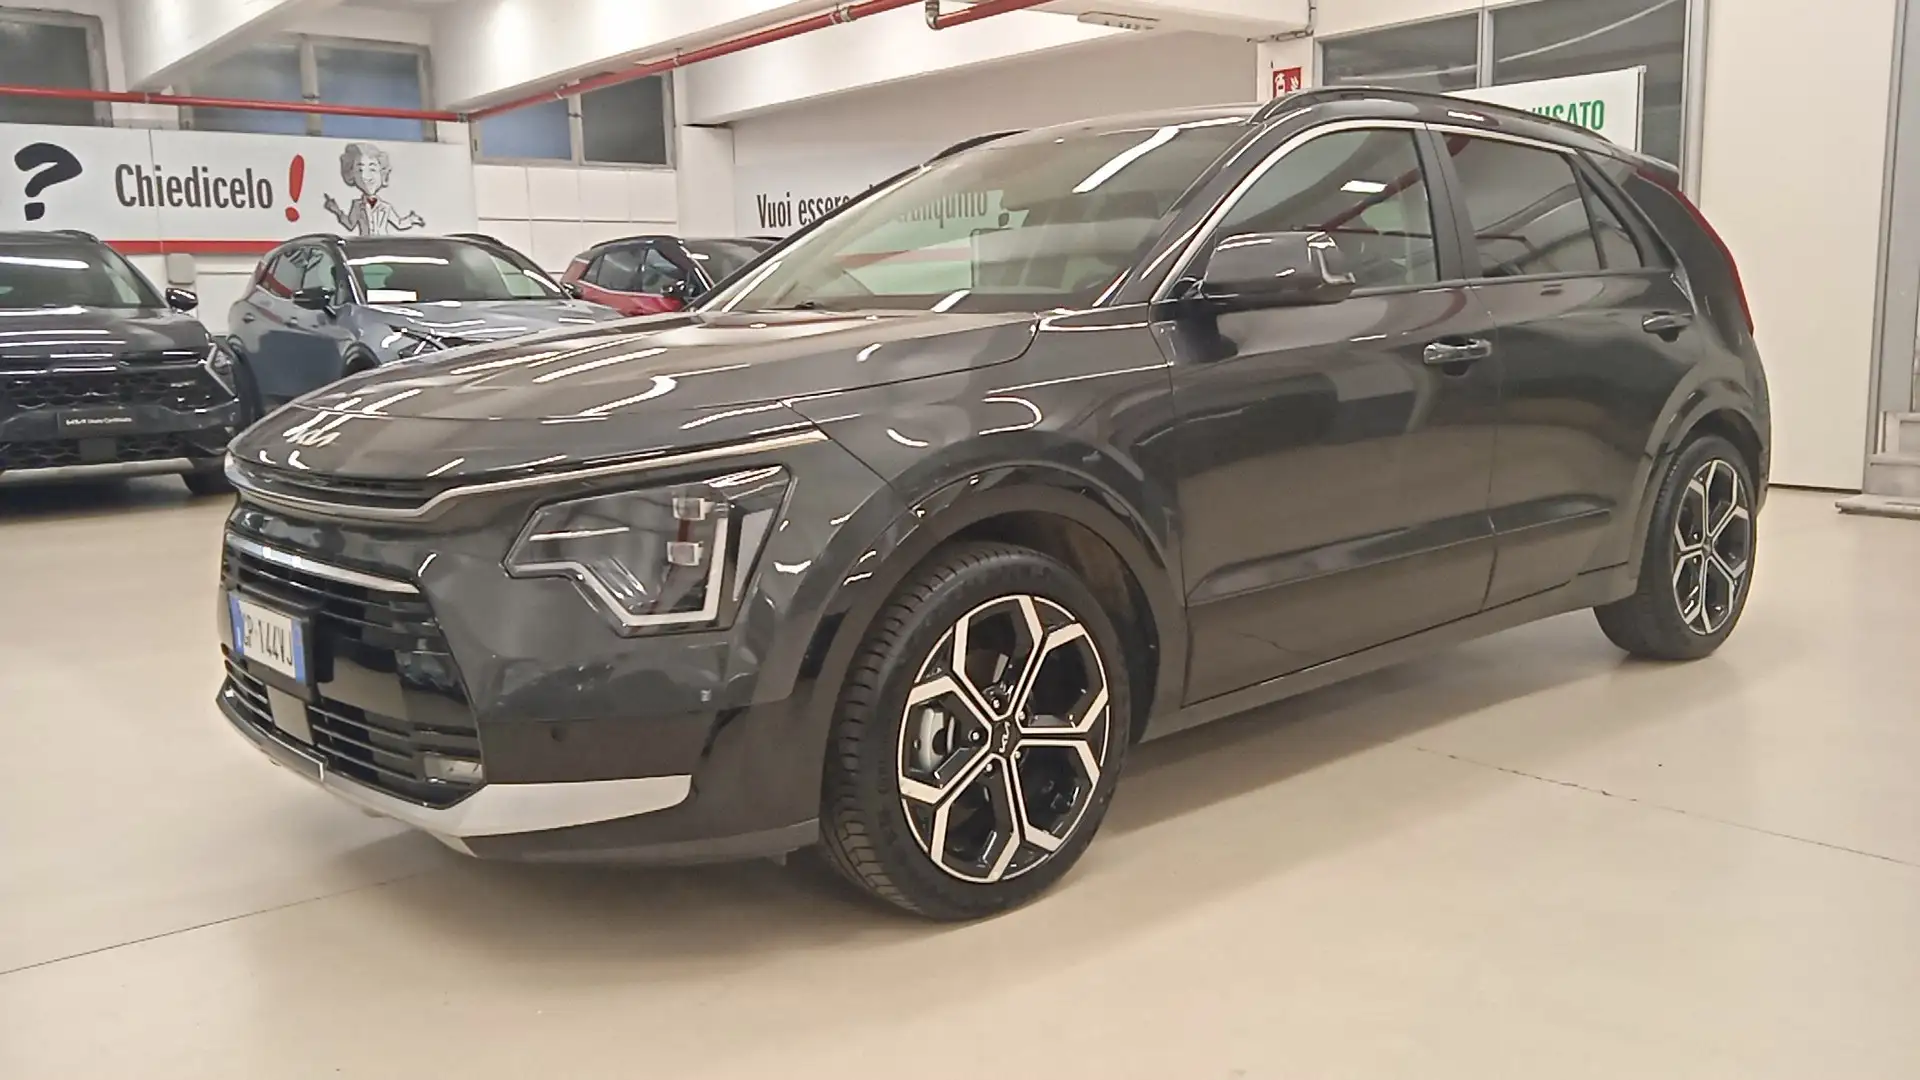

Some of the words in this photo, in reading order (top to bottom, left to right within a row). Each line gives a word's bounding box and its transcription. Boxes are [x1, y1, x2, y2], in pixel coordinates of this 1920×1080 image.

[115, 164, 273, 208] Chiedicelo
[756, 191, 792, 228] Vuoi
[798, 195, 850, 225] esser
